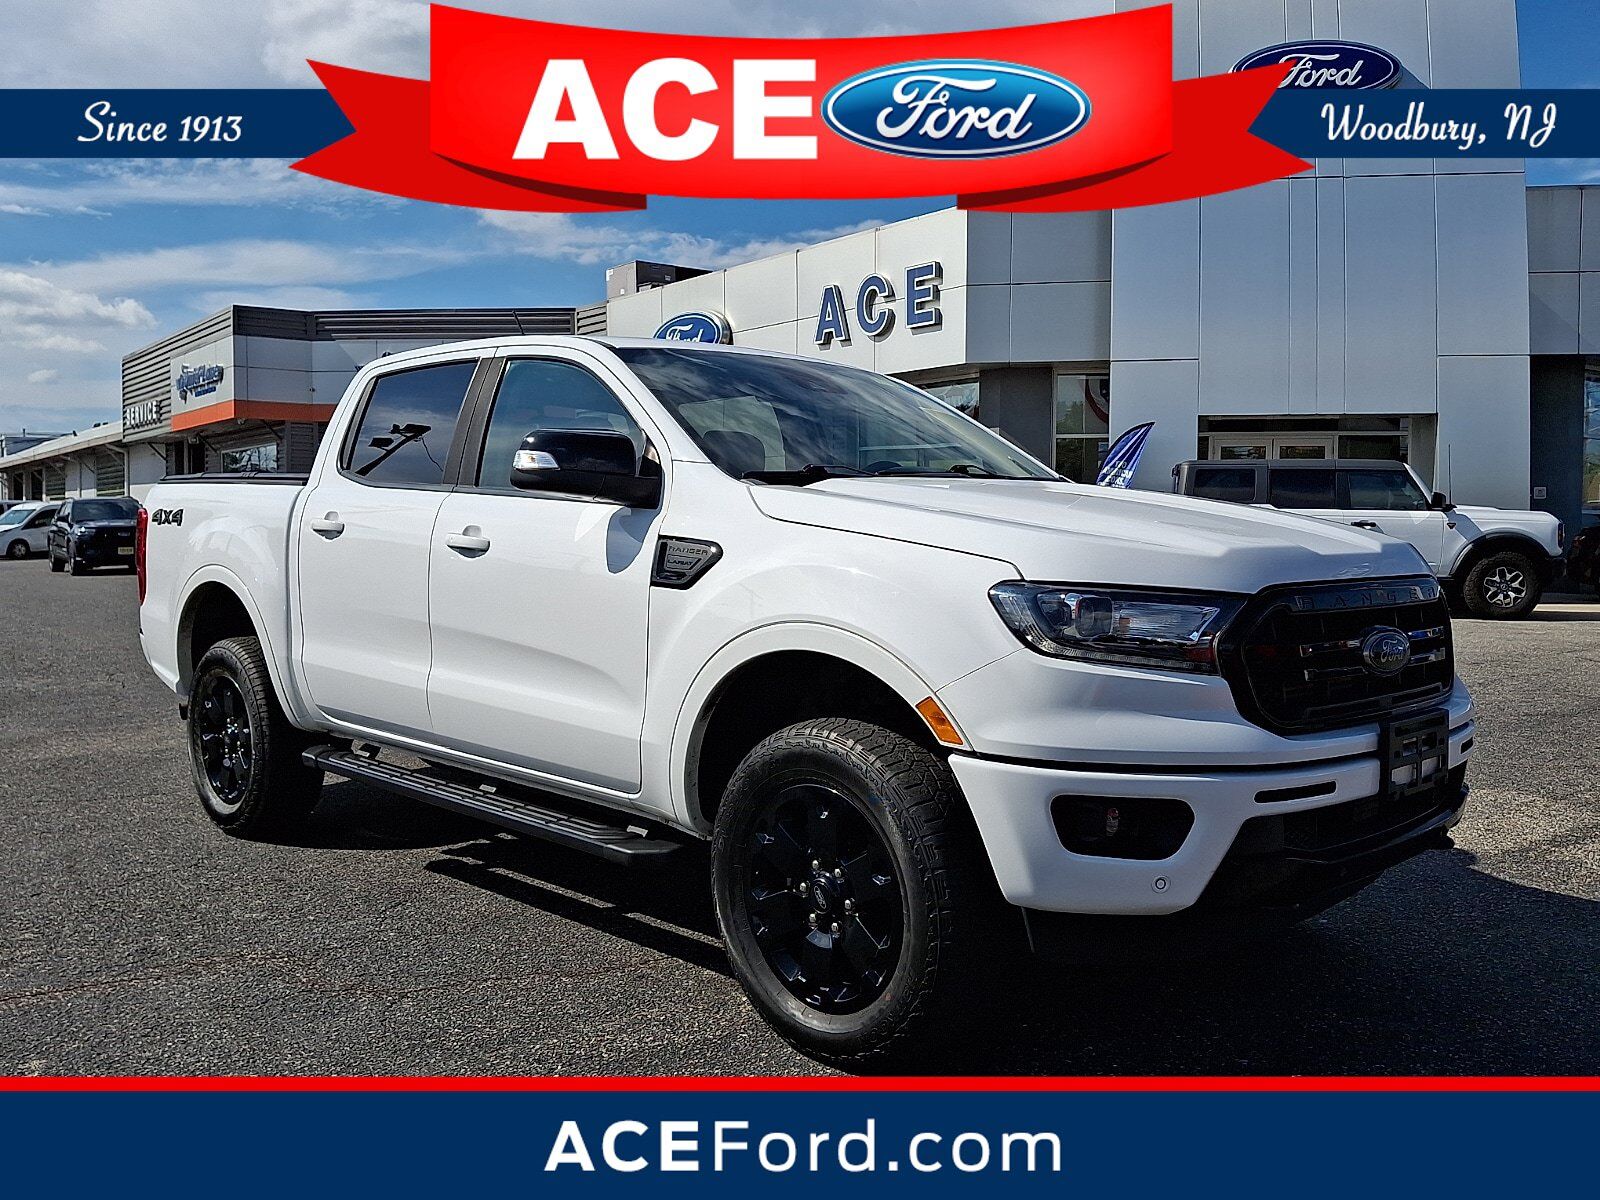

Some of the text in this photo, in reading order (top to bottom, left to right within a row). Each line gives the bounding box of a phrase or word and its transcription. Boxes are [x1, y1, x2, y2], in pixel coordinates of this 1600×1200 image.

[1278, 53, 1364, 89] Ford
[814, 261, 943, 345] ACE
[126, 400, 158, 426] SERVICE
[667, 557, 693, 566] LARIAT
[668, 545, 708, 556] RANGER
[1380, 639, 1408, 663] Ford
